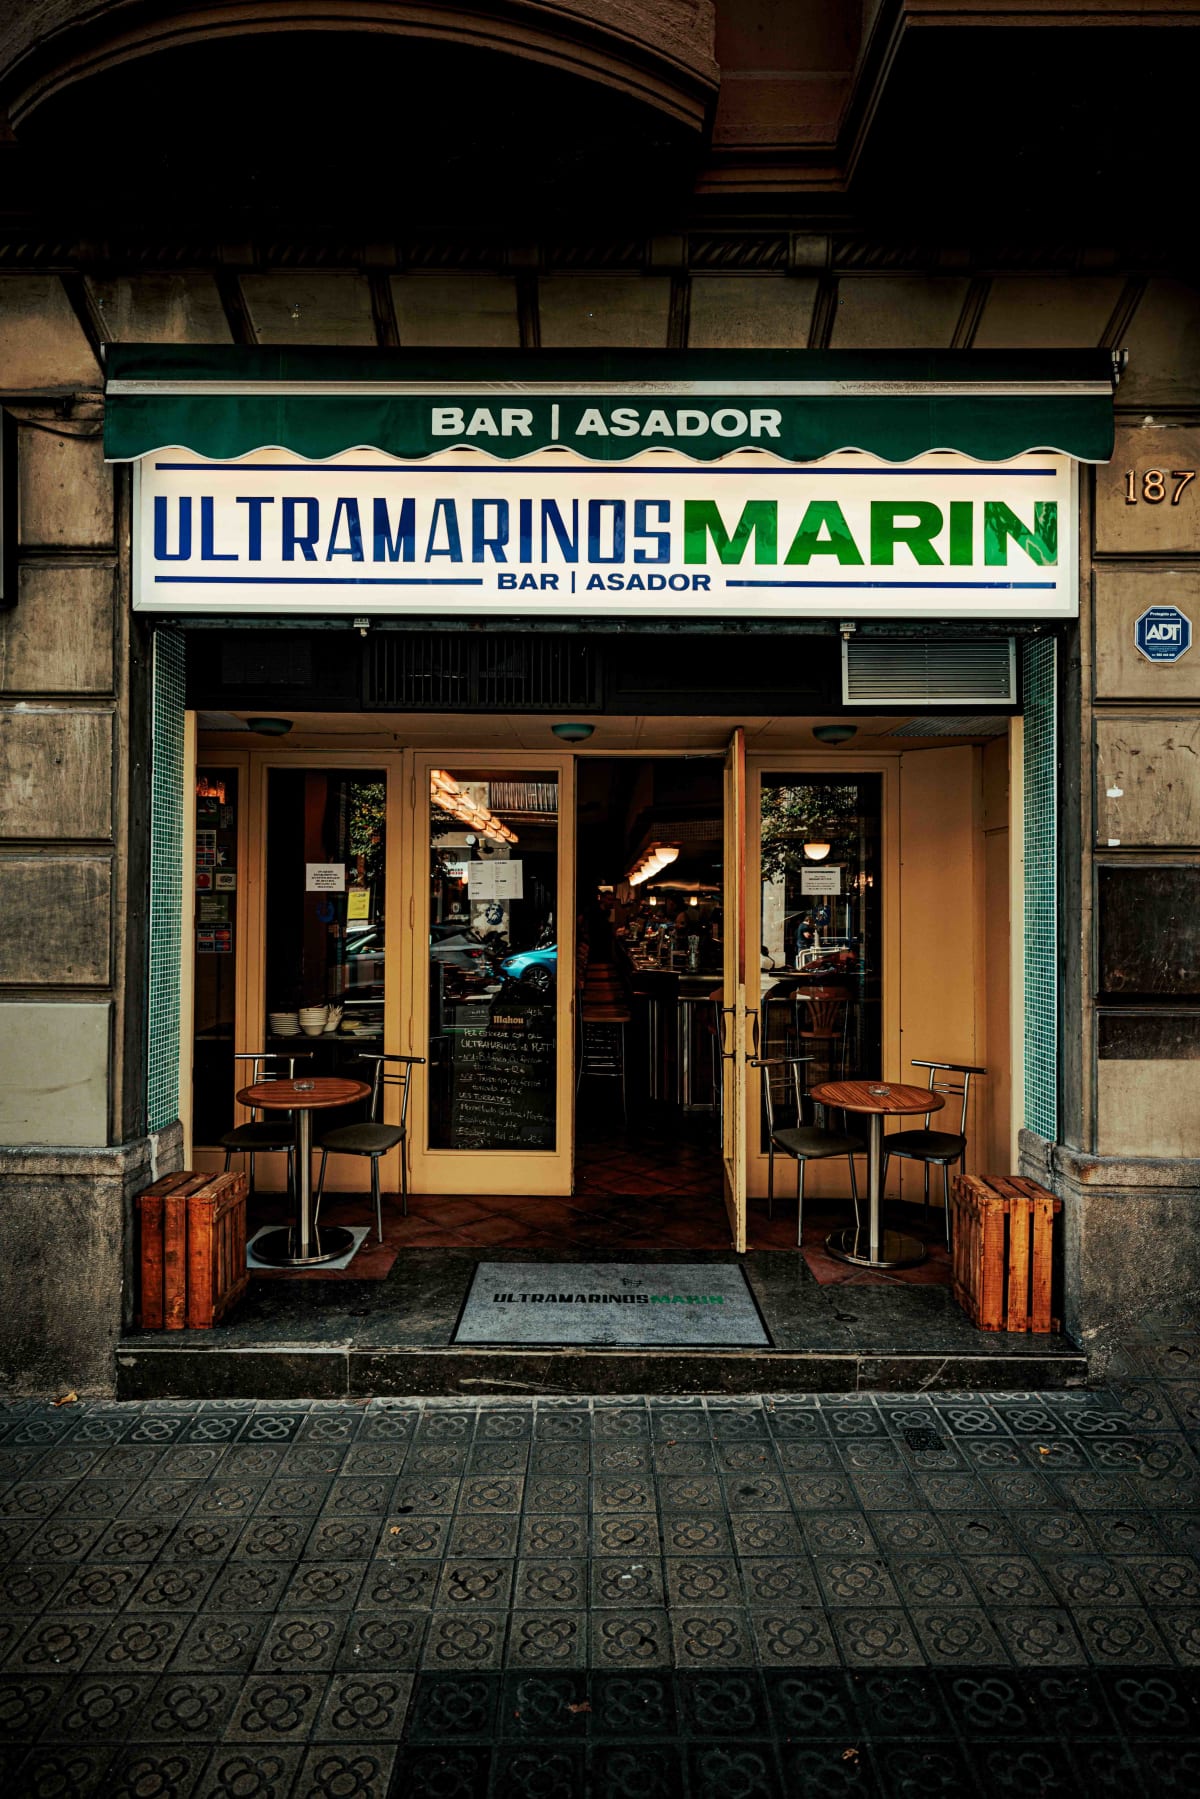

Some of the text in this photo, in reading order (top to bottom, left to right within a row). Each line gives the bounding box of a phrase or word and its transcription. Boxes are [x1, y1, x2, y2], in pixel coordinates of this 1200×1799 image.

[431, 407, 782, 438] BAR ASADOR
[1125, 469, 1196, 505] 187
[154, 496, 1058, 566] ULTRAMARINOS MARIN
[497, 573, 711, 592] BAR ASADOR
[1146, 623, 1180, 641] ADT
[493, 1015, 524, 1024] Mahou
[493, 1293, 724, 1305] ULTRAMARINOS MARIN
